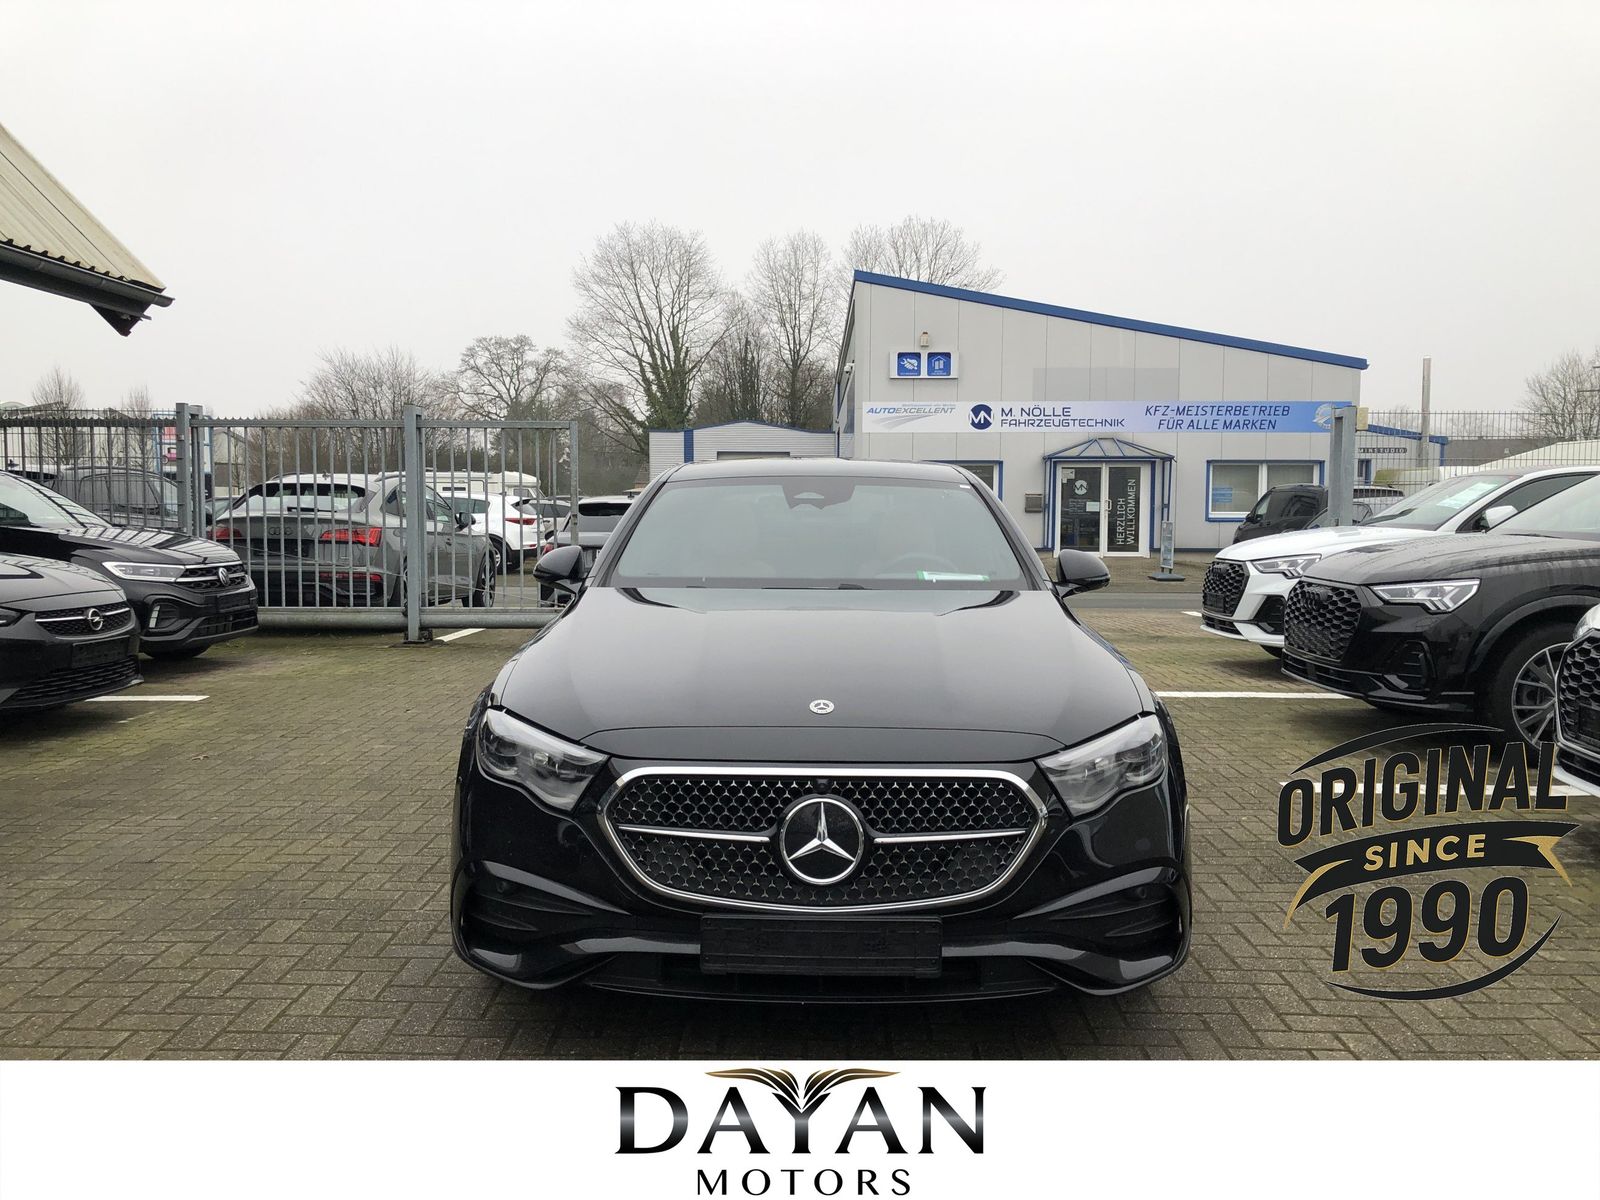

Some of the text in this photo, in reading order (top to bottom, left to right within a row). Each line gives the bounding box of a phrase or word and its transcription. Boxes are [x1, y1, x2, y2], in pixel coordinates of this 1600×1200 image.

[866, 407, 956, 415] AUTOEXCELLENT
[1000, 405, 1072, 417] M. NÖLLE
[1144, 405, 1290, 416] KFZ-MEISTERBETRIEB
[1000, 418, 1125, 428] FAHRZEUGTECHNIK
[1157, 418, 1277, 430] FÜR ALLE MARKEN
[1126, 479, 1136, 545] WILLKOMMEN
[1116, 498, 1126, 545] HERZLICH
